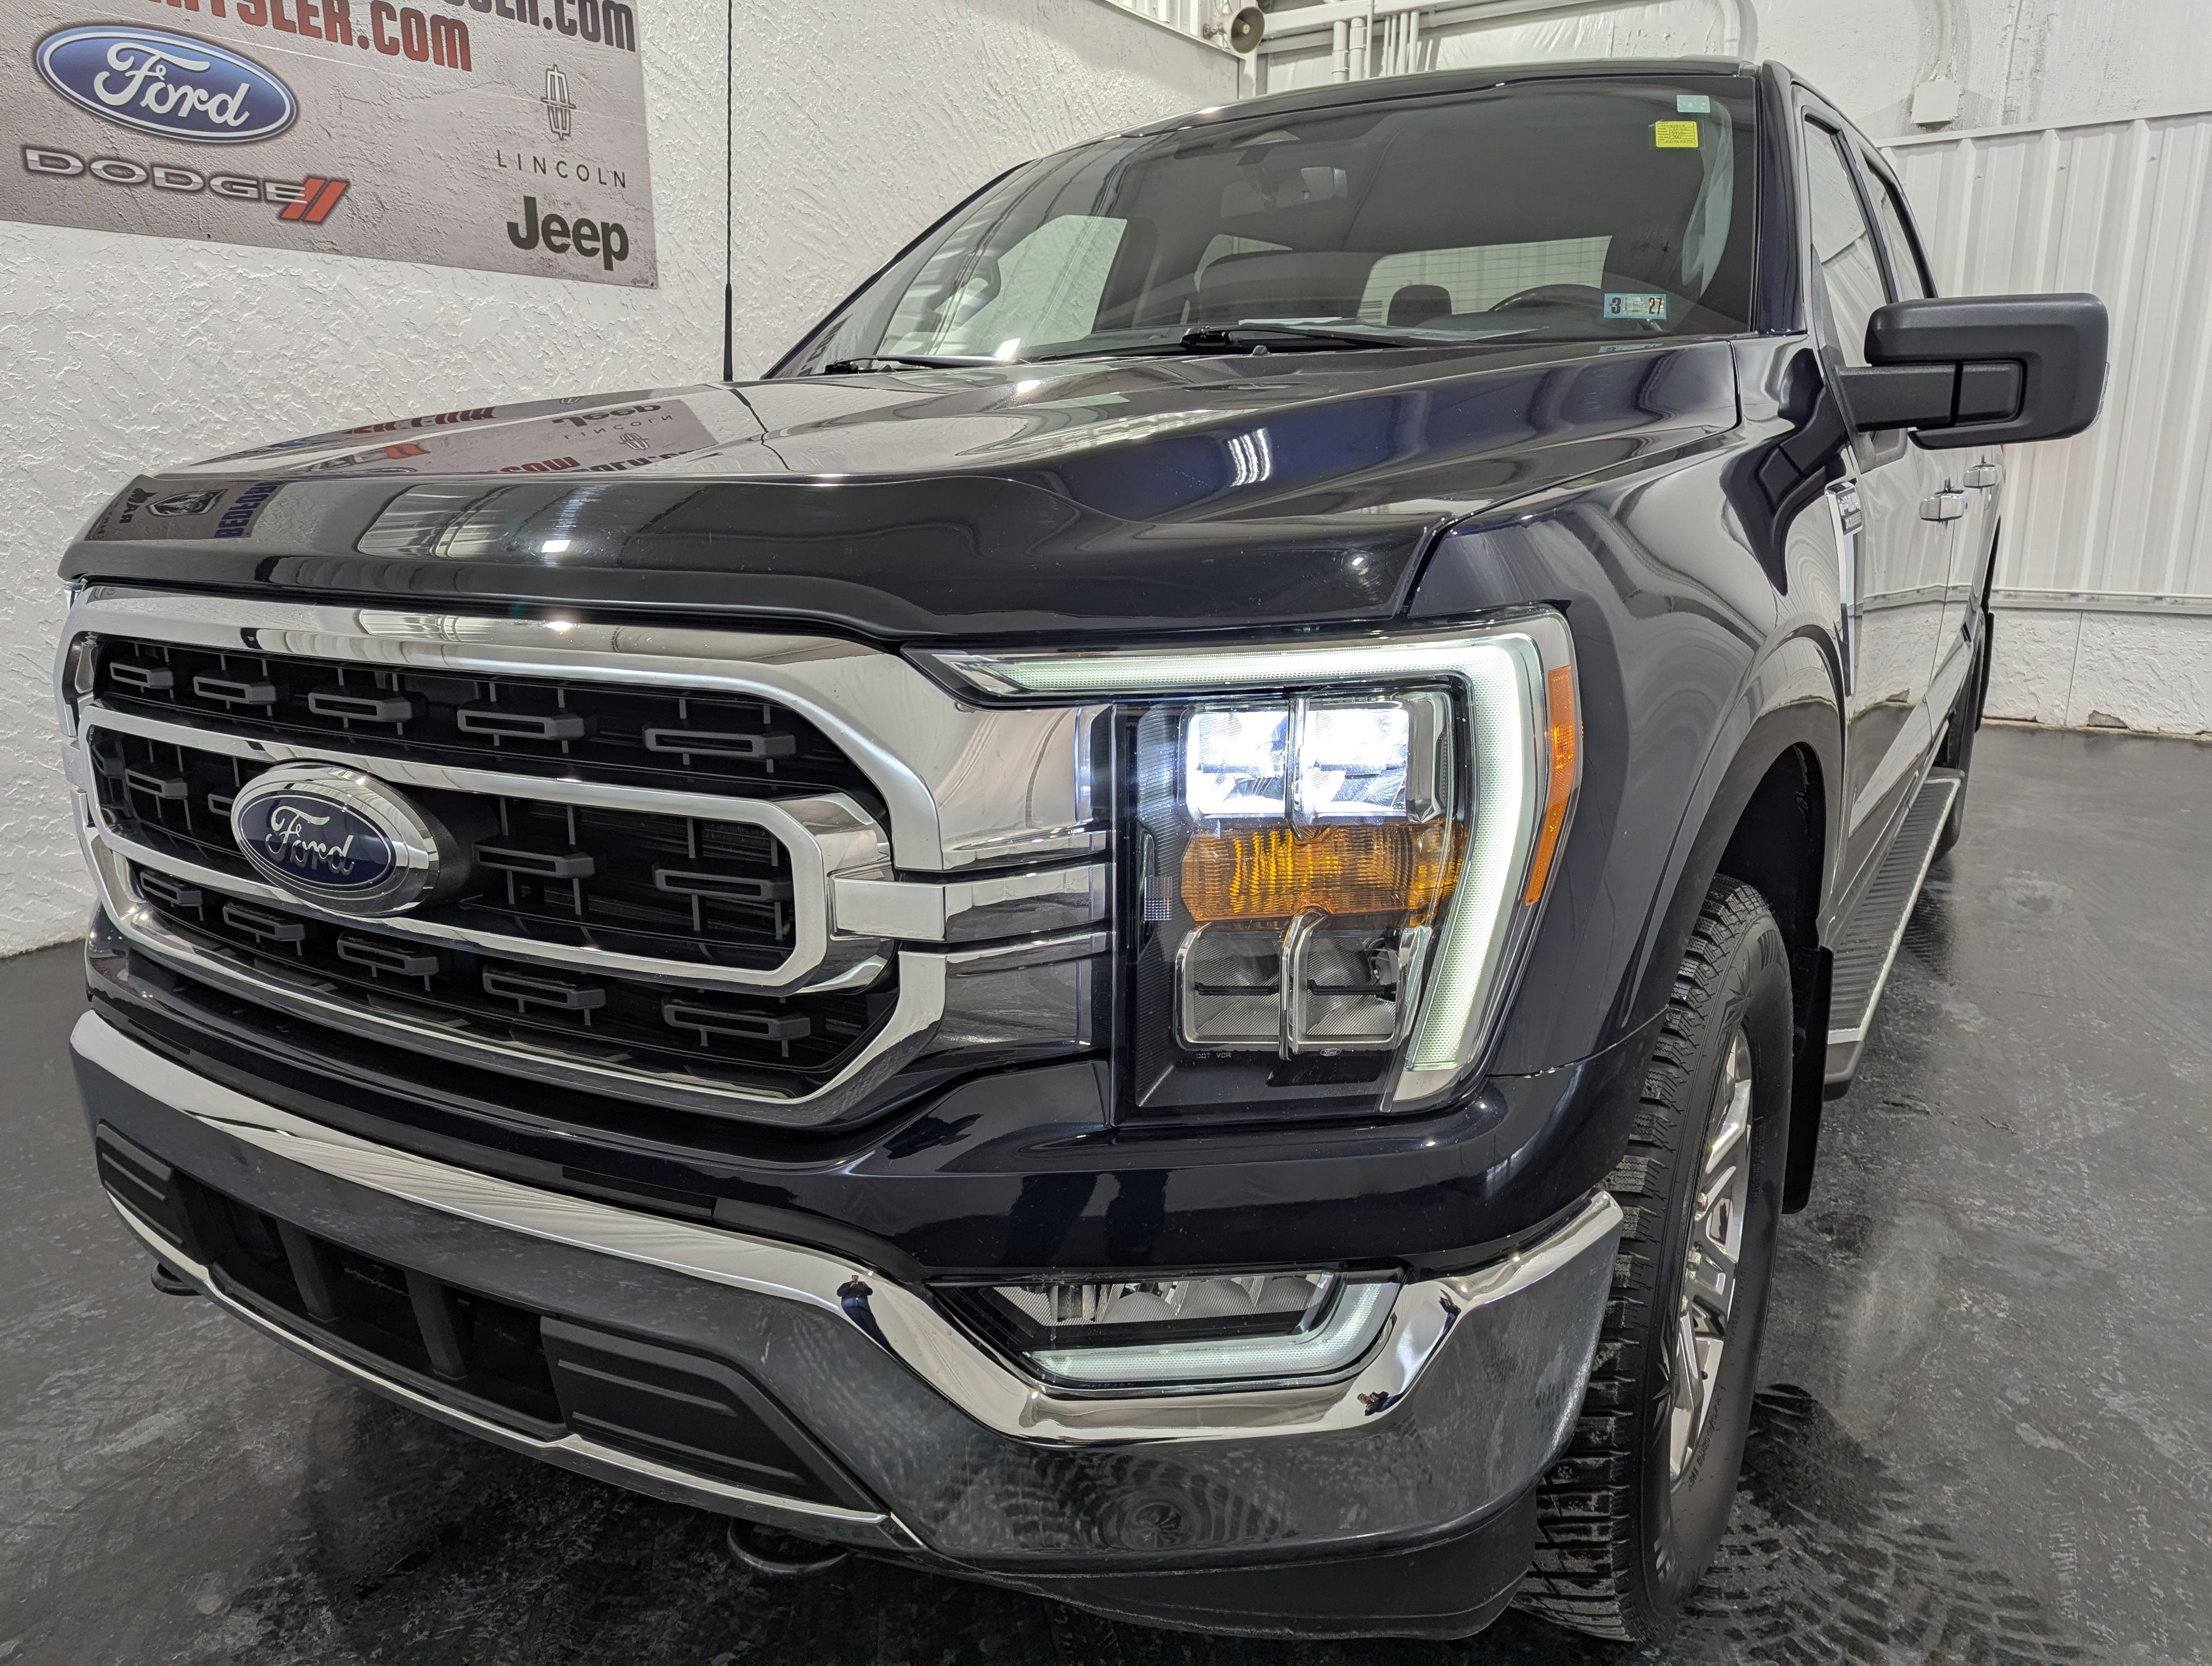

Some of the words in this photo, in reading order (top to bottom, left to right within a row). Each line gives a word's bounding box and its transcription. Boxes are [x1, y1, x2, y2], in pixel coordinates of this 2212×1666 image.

[93, 42, 249, 127] Ford
[25, 149, 307, 204] DODGE
[497, 149, 626, 188] LINCOLN
[506, 195, 629, 271] Jeep
[1611, 297, 1622, 314] 3
[1649, 297, 1662, 315] 27
[265, 805, 355, 876] Ford
